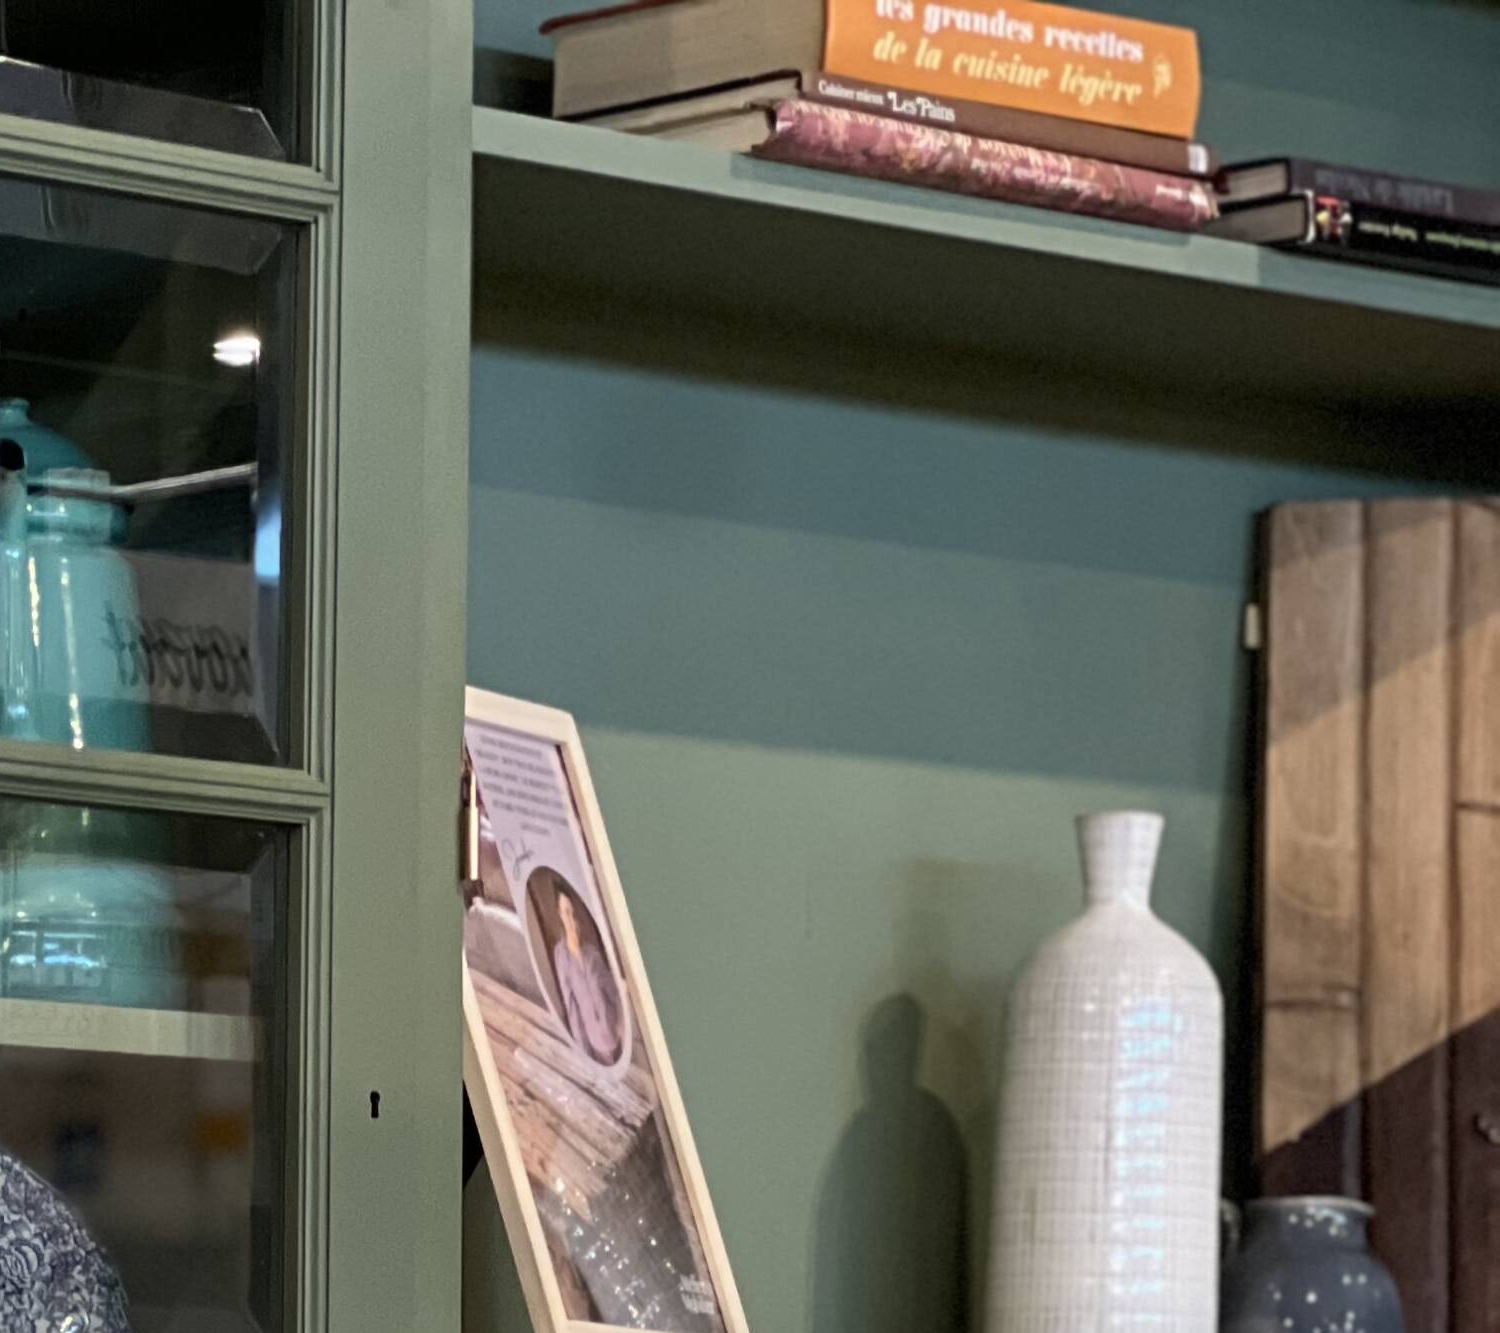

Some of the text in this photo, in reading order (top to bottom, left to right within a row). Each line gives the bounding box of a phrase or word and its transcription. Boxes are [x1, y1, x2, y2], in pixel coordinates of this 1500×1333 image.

[923, 3, 1034, 43] grandes
[1044, 25, 1144, 63] recettes
[873, 31, 1142, 106] de la cuisine légère
[886, 91, 917, 116] Les
[915, 96, 956, 122] Pains
